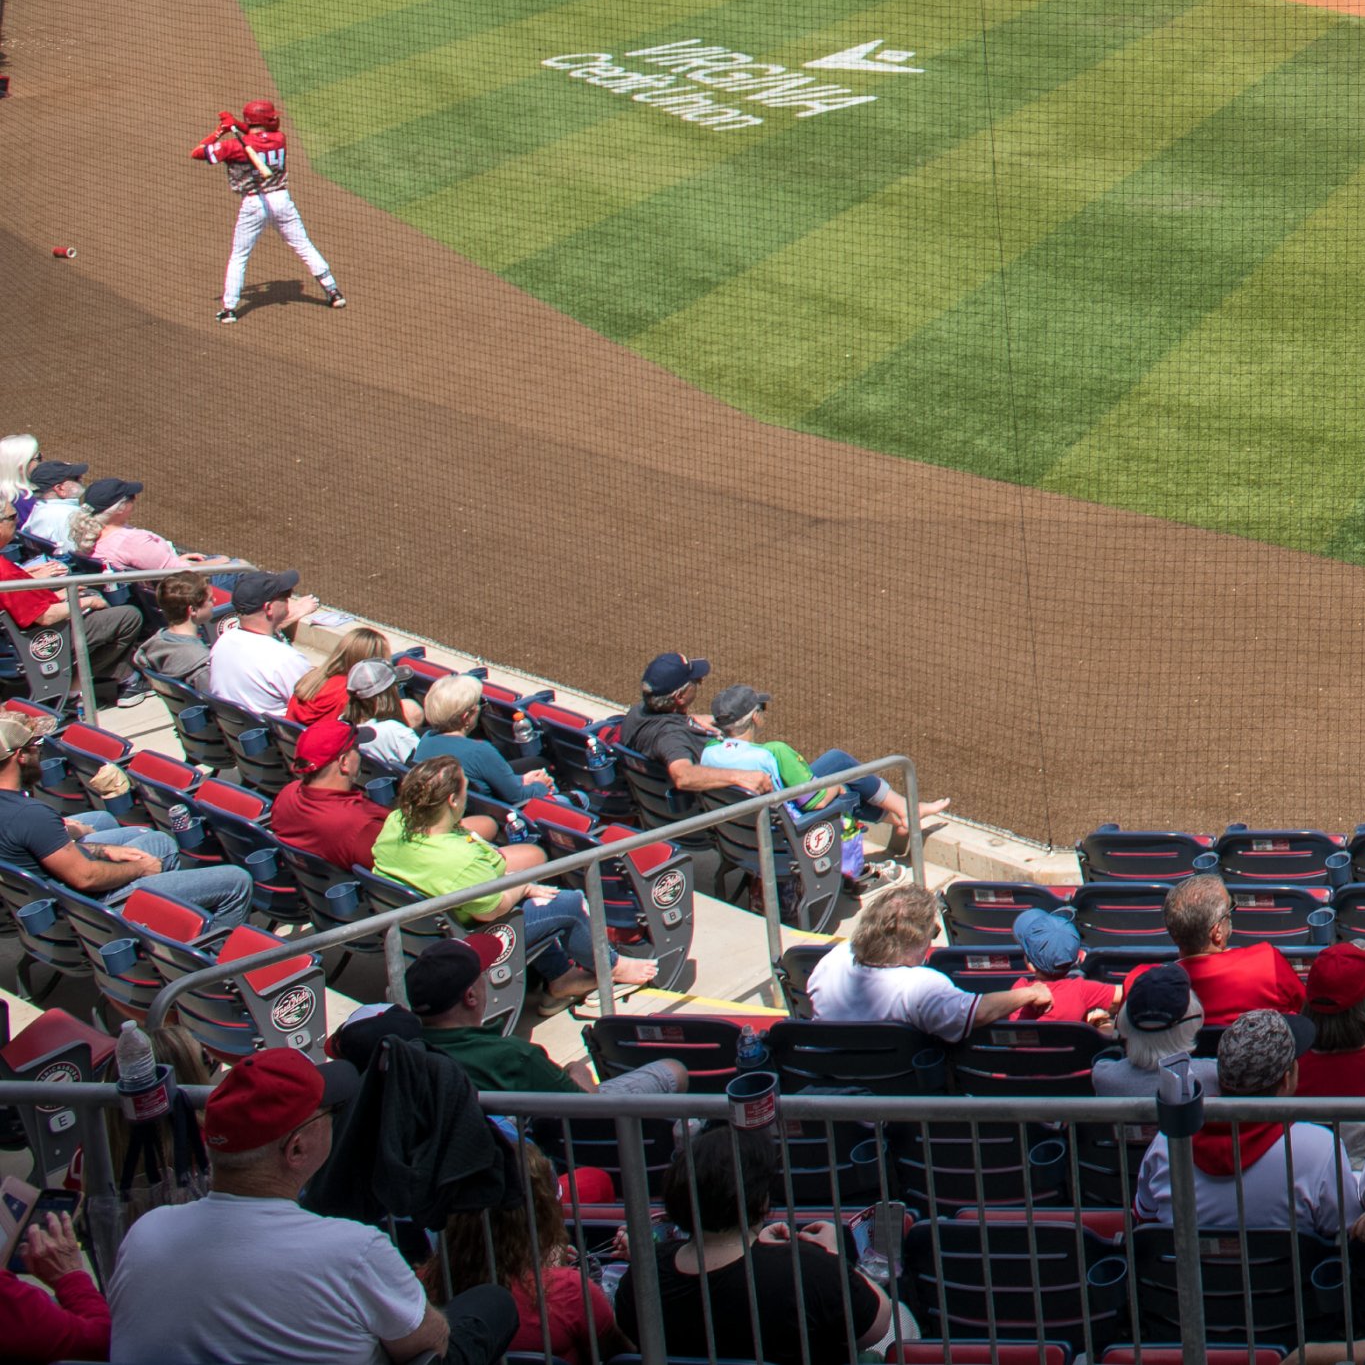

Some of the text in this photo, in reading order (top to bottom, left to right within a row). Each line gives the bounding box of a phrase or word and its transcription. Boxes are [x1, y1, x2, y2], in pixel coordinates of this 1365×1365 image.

[625, 39, 878, 118] VIRGINIA
[541, 53, 764, 131] Credit Union
[669, 911, 677, 921] B
[295, 1035, 304, 1045] D
[58, 1115, 67, 1127] E
